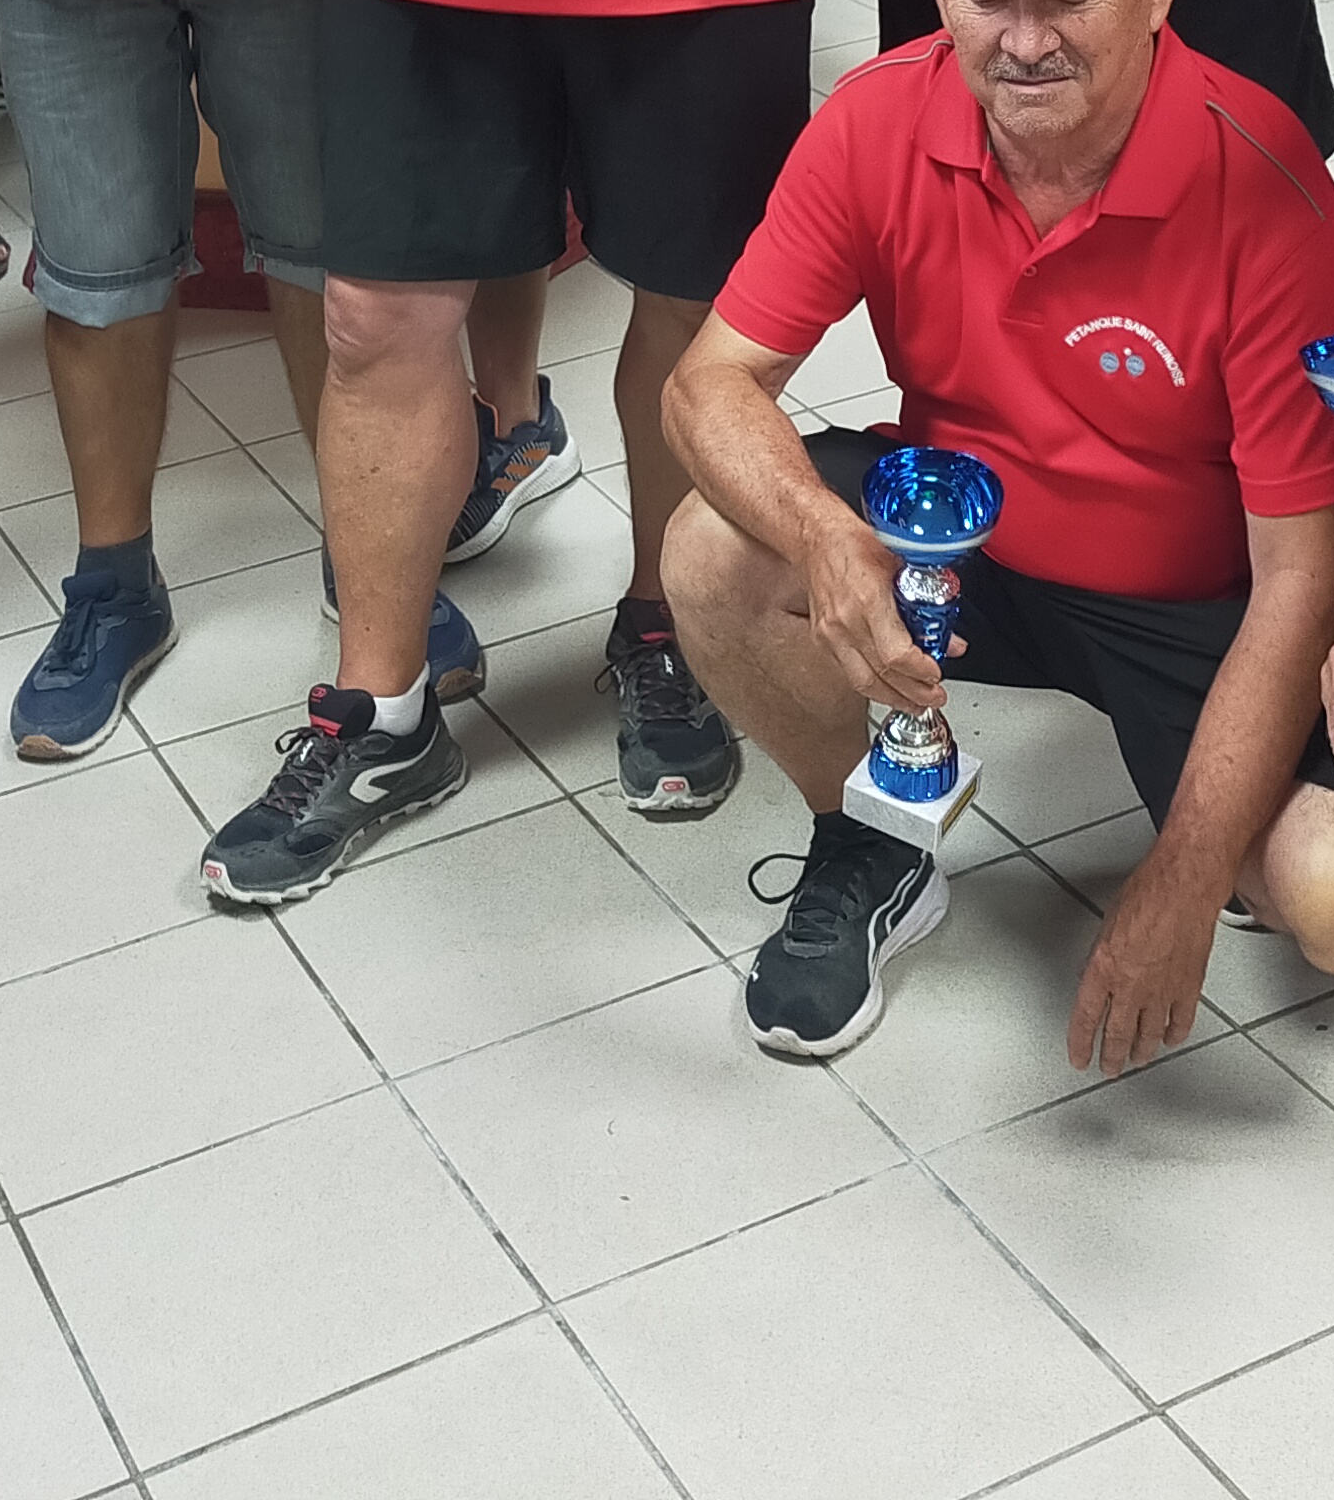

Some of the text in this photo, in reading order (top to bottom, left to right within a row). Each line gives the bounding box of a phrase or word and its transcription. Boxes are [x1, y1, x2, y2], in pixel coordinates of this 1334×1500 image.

[1064, 315, 1186, 388] PETANQUE SAINT REMOISE
